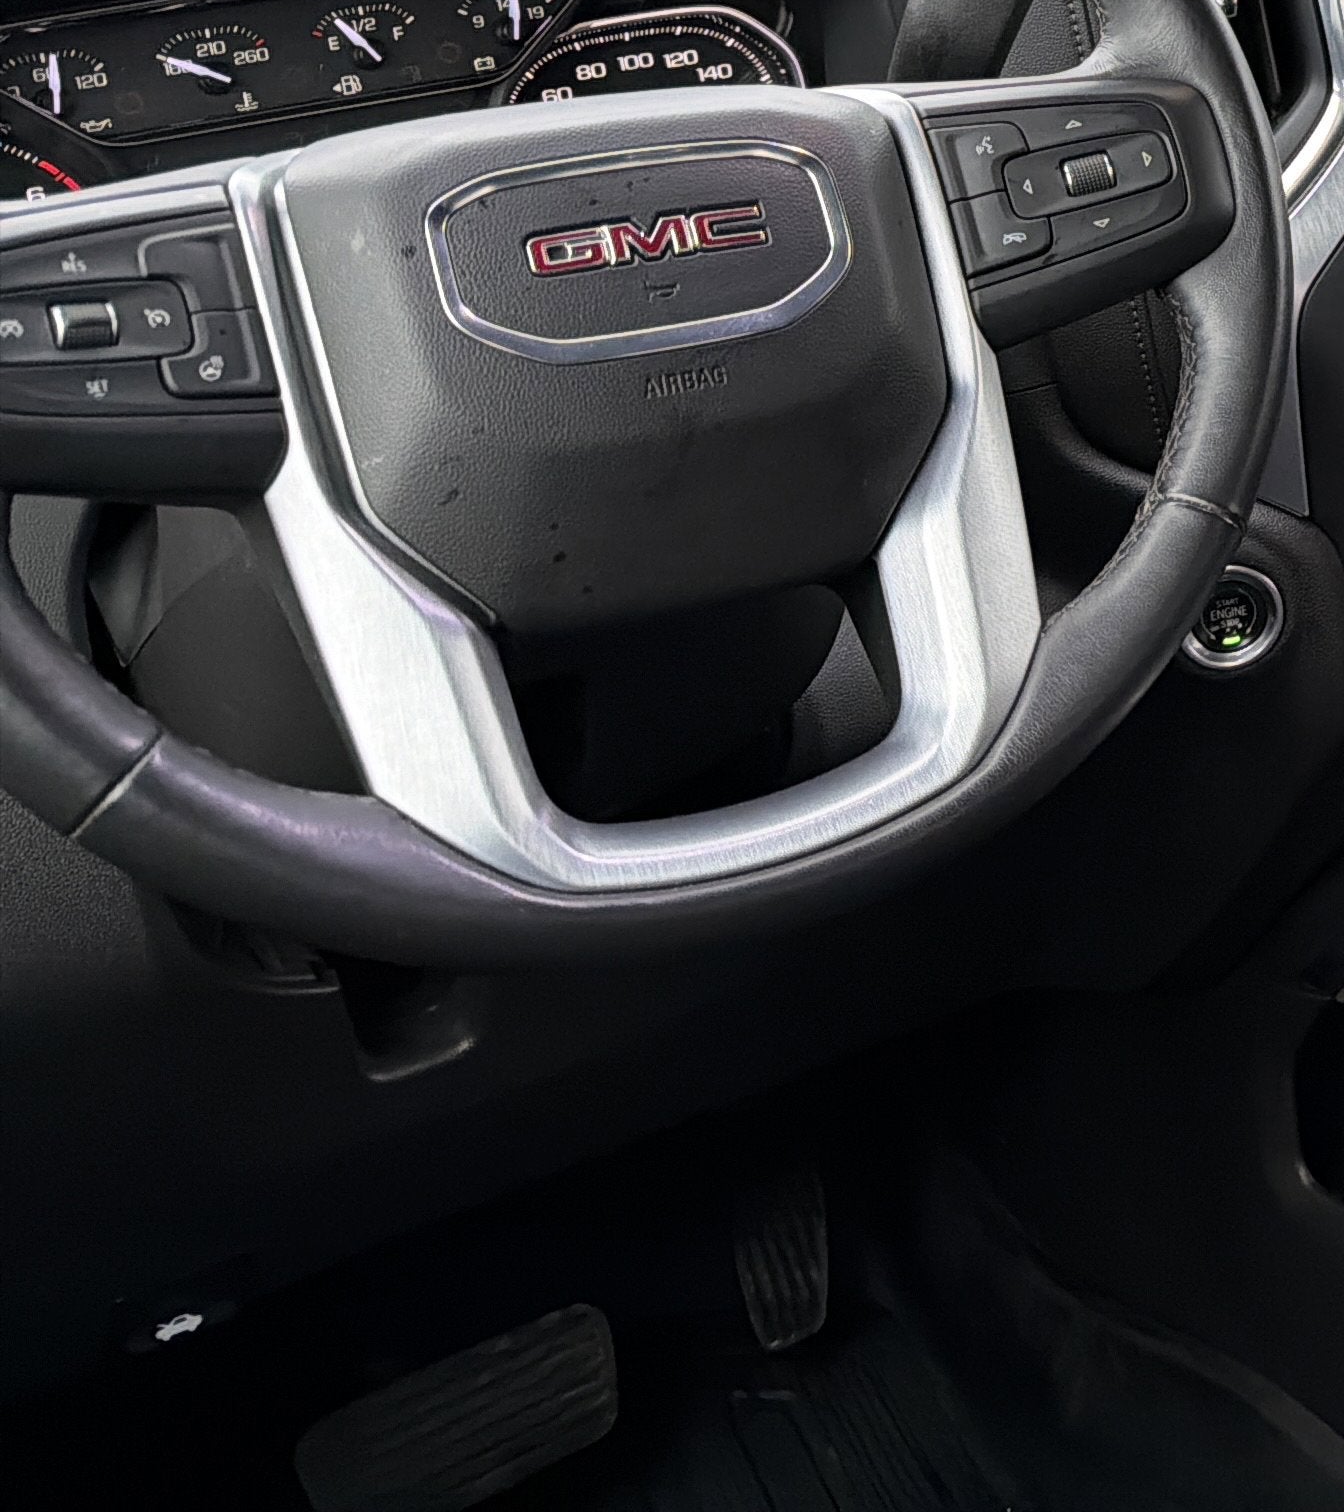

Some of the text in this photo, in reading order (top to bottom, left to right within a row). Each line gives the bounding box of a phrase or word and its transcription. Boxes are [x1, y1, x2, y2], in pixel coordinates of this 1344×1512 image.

[472, 14, 485, 29] 9
[526, 5, 545, 20] 19
[392, 25, 404, 41] F
[195, 40, 227, 58] 210
[327, 36, 340, 51] E
[232, 46, 270, 66] 260
[616, 52, 655, 71] 100
[662, 49, 699, 69] 120
[575, 62, 607, 81] 80
[695, 63, 734, 82] 140
[74, 72, 108, 90] 120
[541, 86, 574, 103] 60
[525, 200, 769, 276] GMC
[646, 367, 729, 399] AIRBAG
[1215, 597, 1240, 609] START
[1210, 605, 1249, 622] ENGINE
